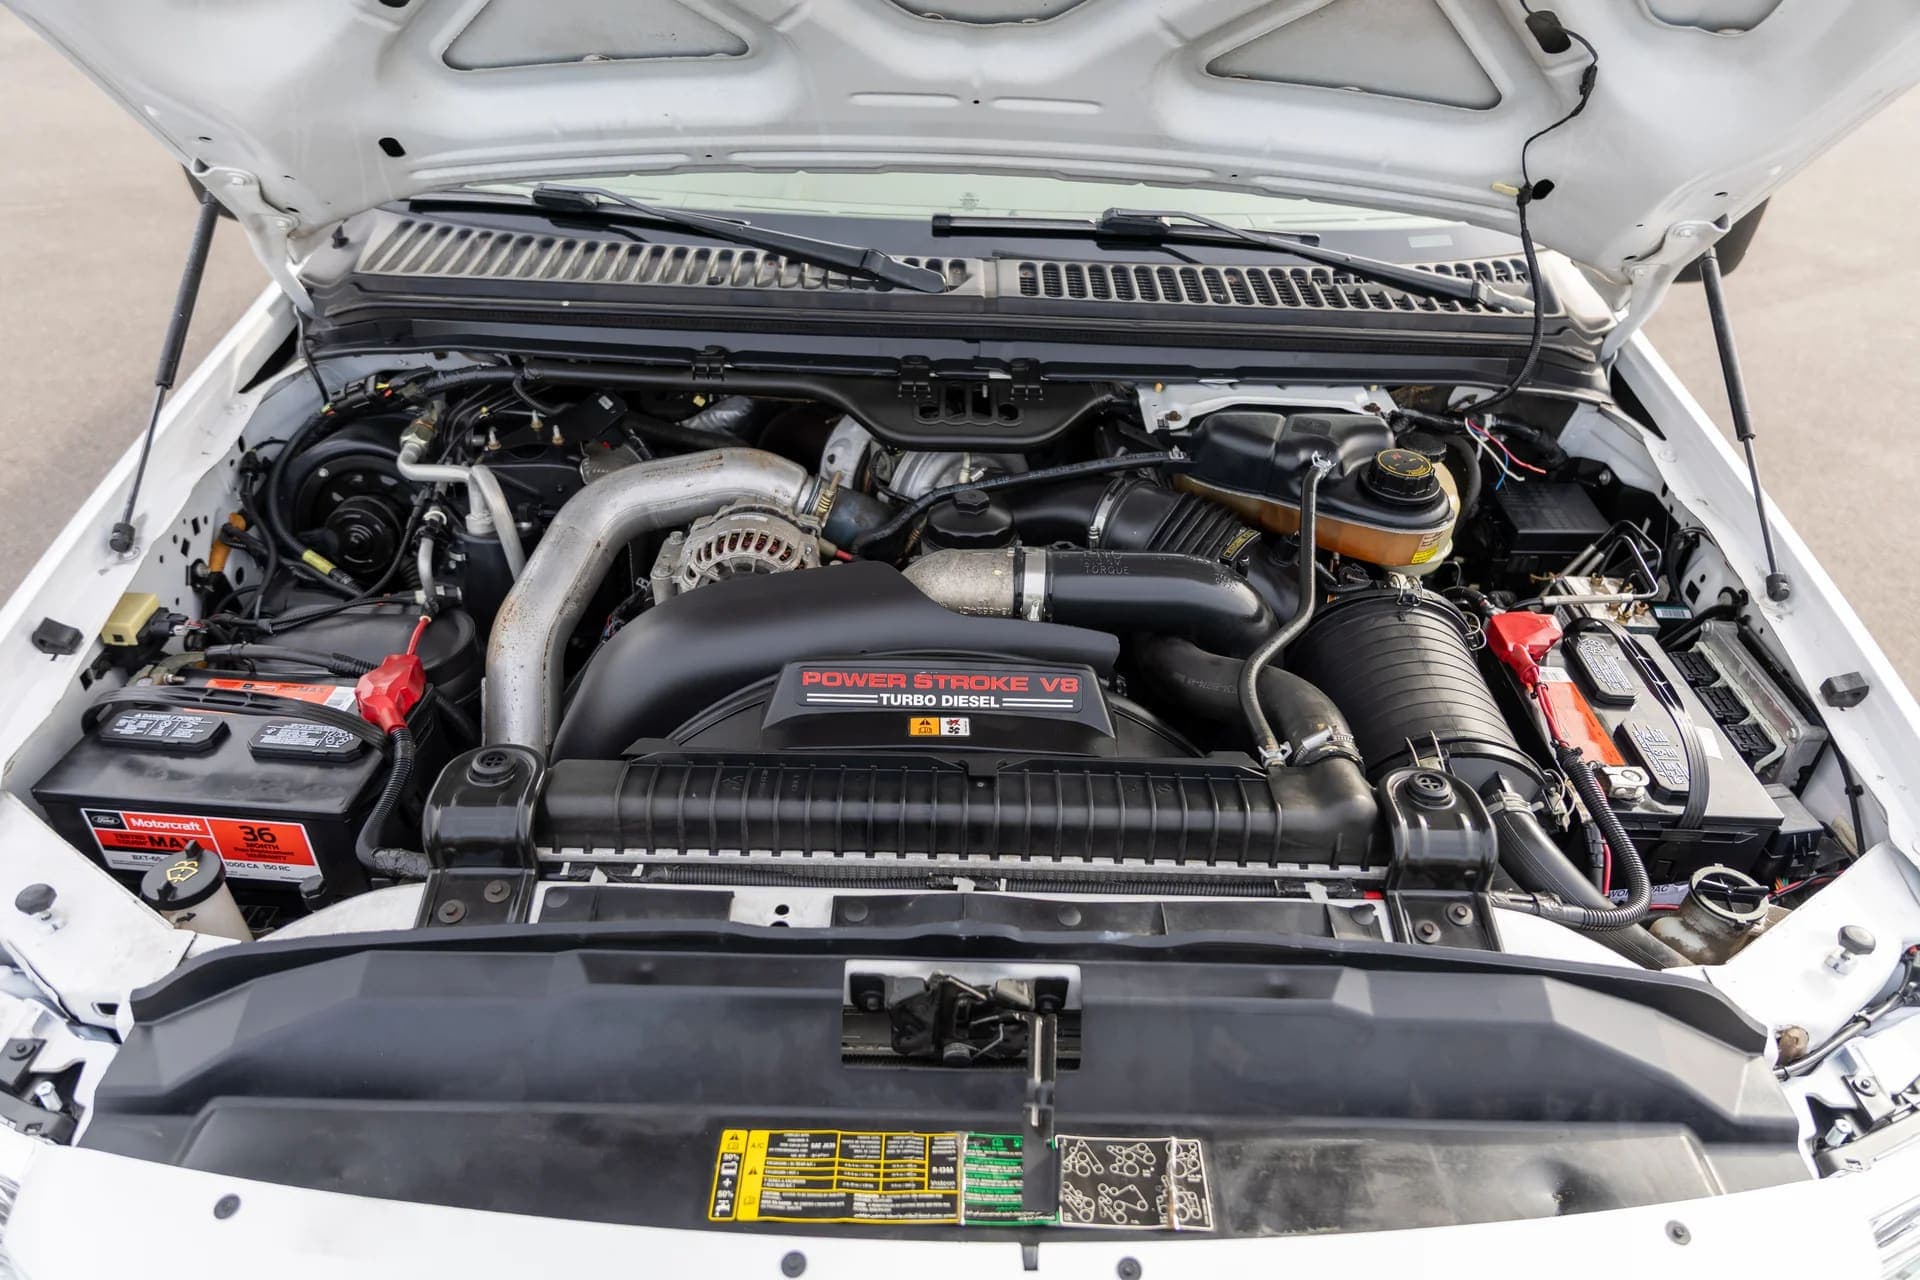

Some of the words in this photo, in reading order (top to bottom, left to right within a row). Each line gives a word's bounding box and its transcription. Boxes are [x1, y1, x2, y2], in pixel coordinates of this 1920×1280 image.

[1083, 565, 1129, 574] TORQUE
[802, 671, 907, 689] POWER
[913, 673, 1029, 692] STROKE
[1040, 677, 1079, 693] V8
[880, 693, 937, 706] TURBO
[941, 694, 1000, 708] DIESEL
[130, 818, 202, 832] Motorcraft
[238, 825, 277, 844] 36
[246, 842, 280, 850] MONTH
[247, 862, 260, 870] CA
